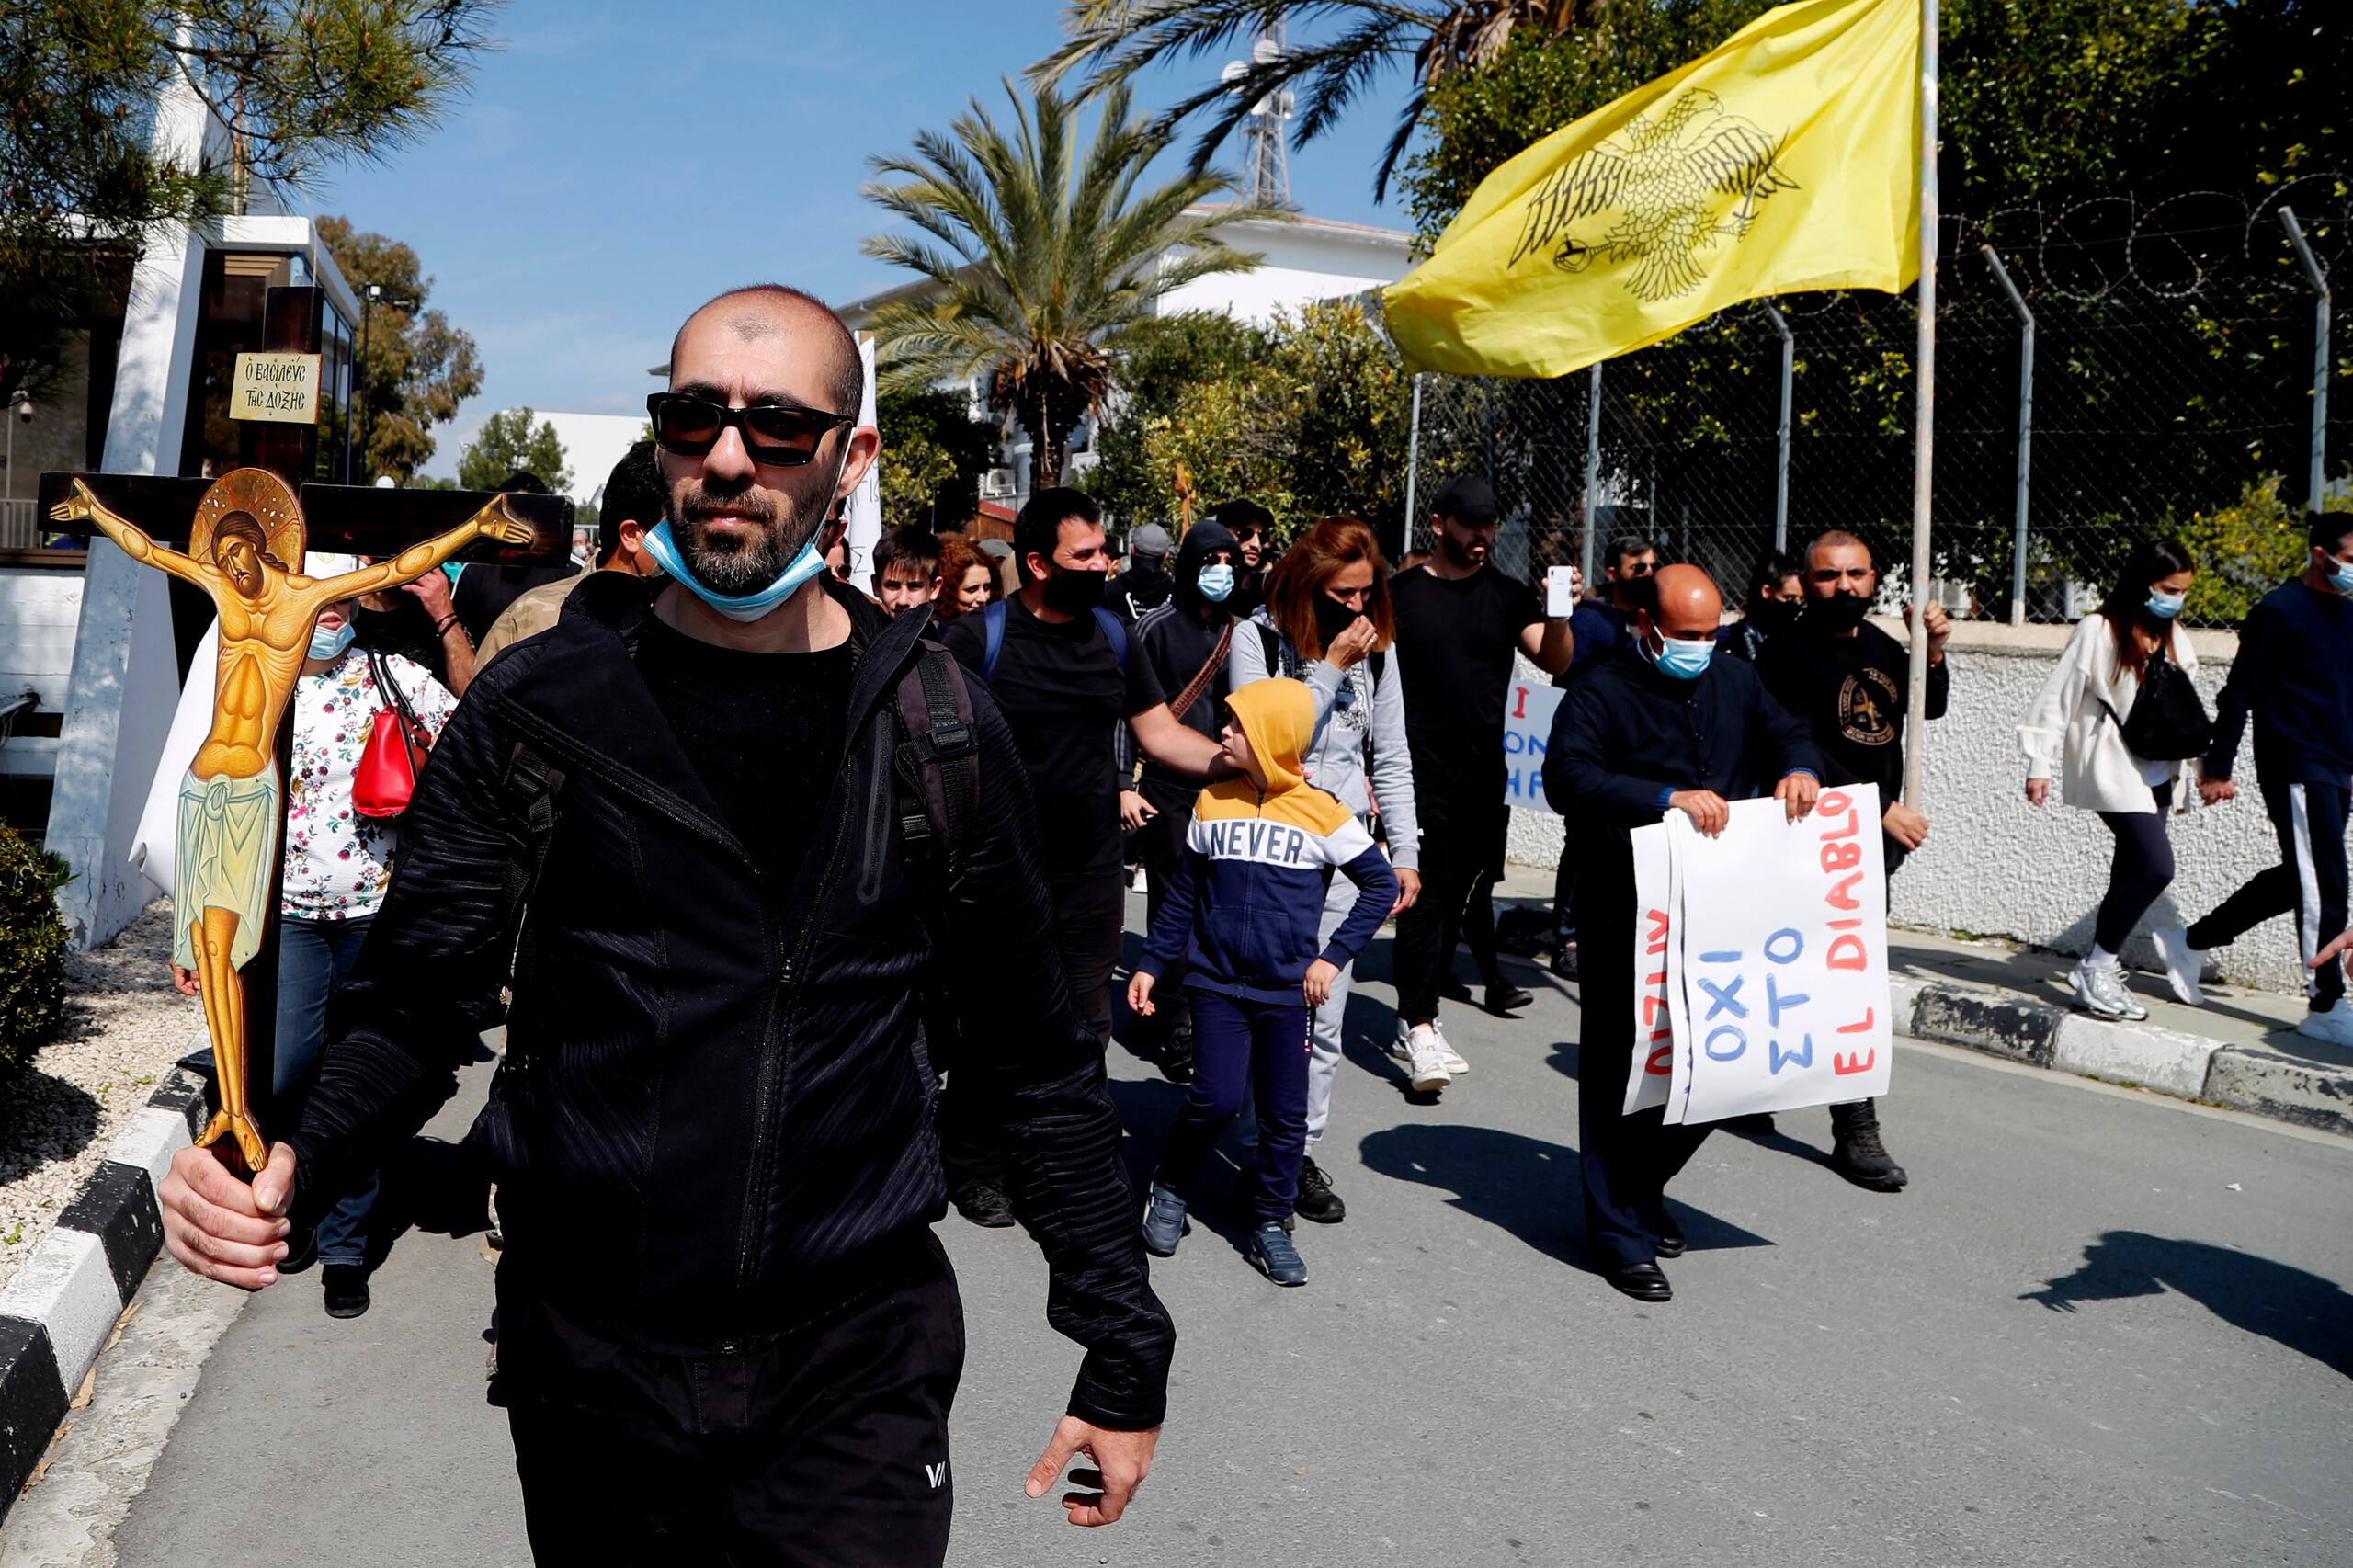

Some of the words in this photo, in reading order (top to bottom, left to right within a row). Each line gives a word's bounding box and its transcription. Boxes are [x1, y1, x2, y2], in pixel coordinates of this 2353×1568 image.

[1211, 822, 1304, 864] NEVER
[1815, 791, 1868, 972] DIABLO
[1697, 950, 1750, 1062] ΟΧΙ
[1764, 927, 1813, 1075] ΣΤΟ
[1833, 1006, 1875, 1076] EL
